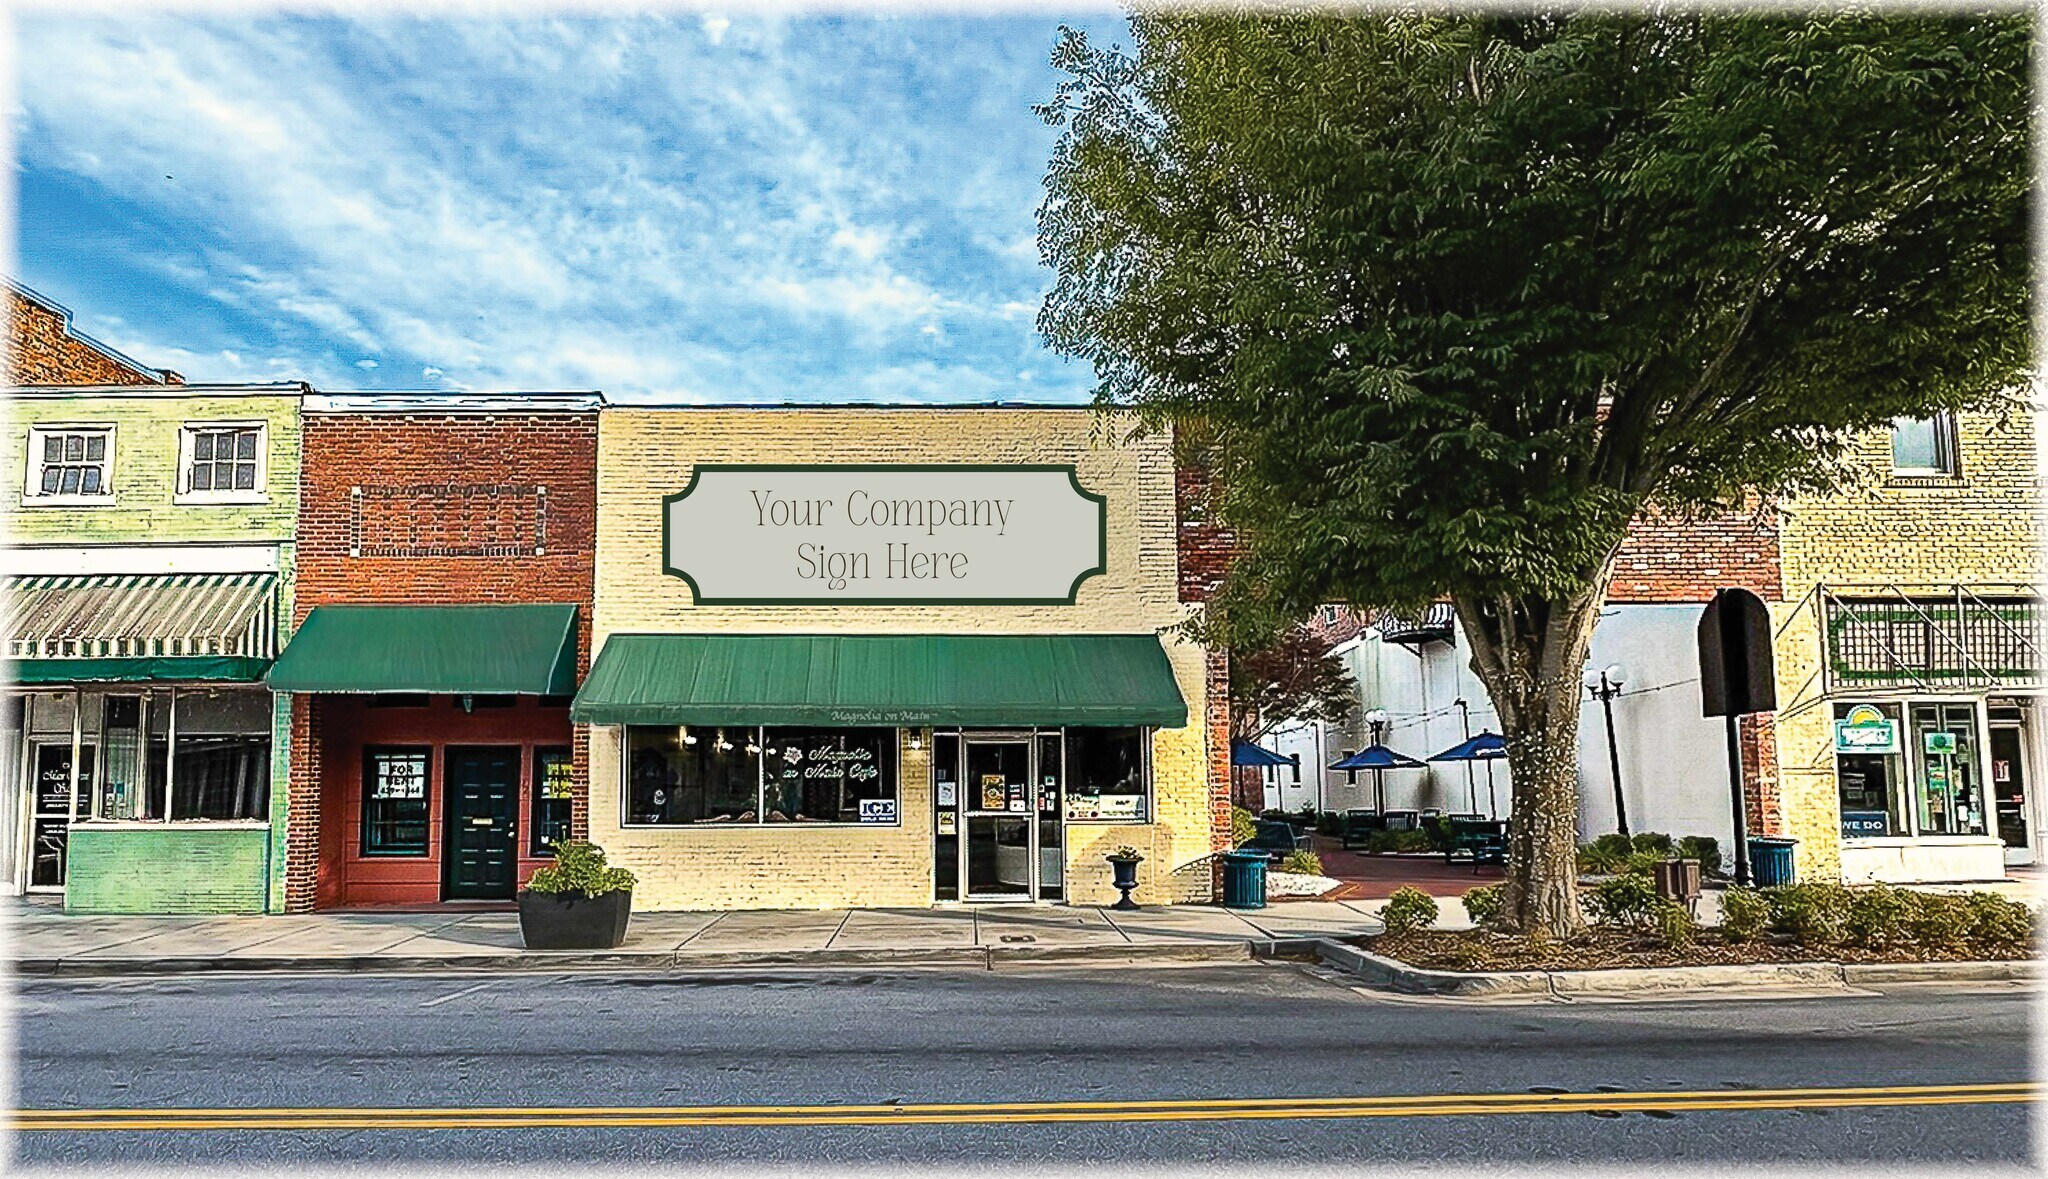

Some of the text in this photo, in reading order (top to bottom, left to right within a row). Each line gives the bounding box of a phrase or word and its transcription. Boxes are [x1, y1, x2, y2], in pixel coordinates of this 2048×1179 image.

[831, 709, 931, 724] Magnolia on Main
[862, 801, 894, 815] ICE
[1863, 821, 1883, 830] DO
